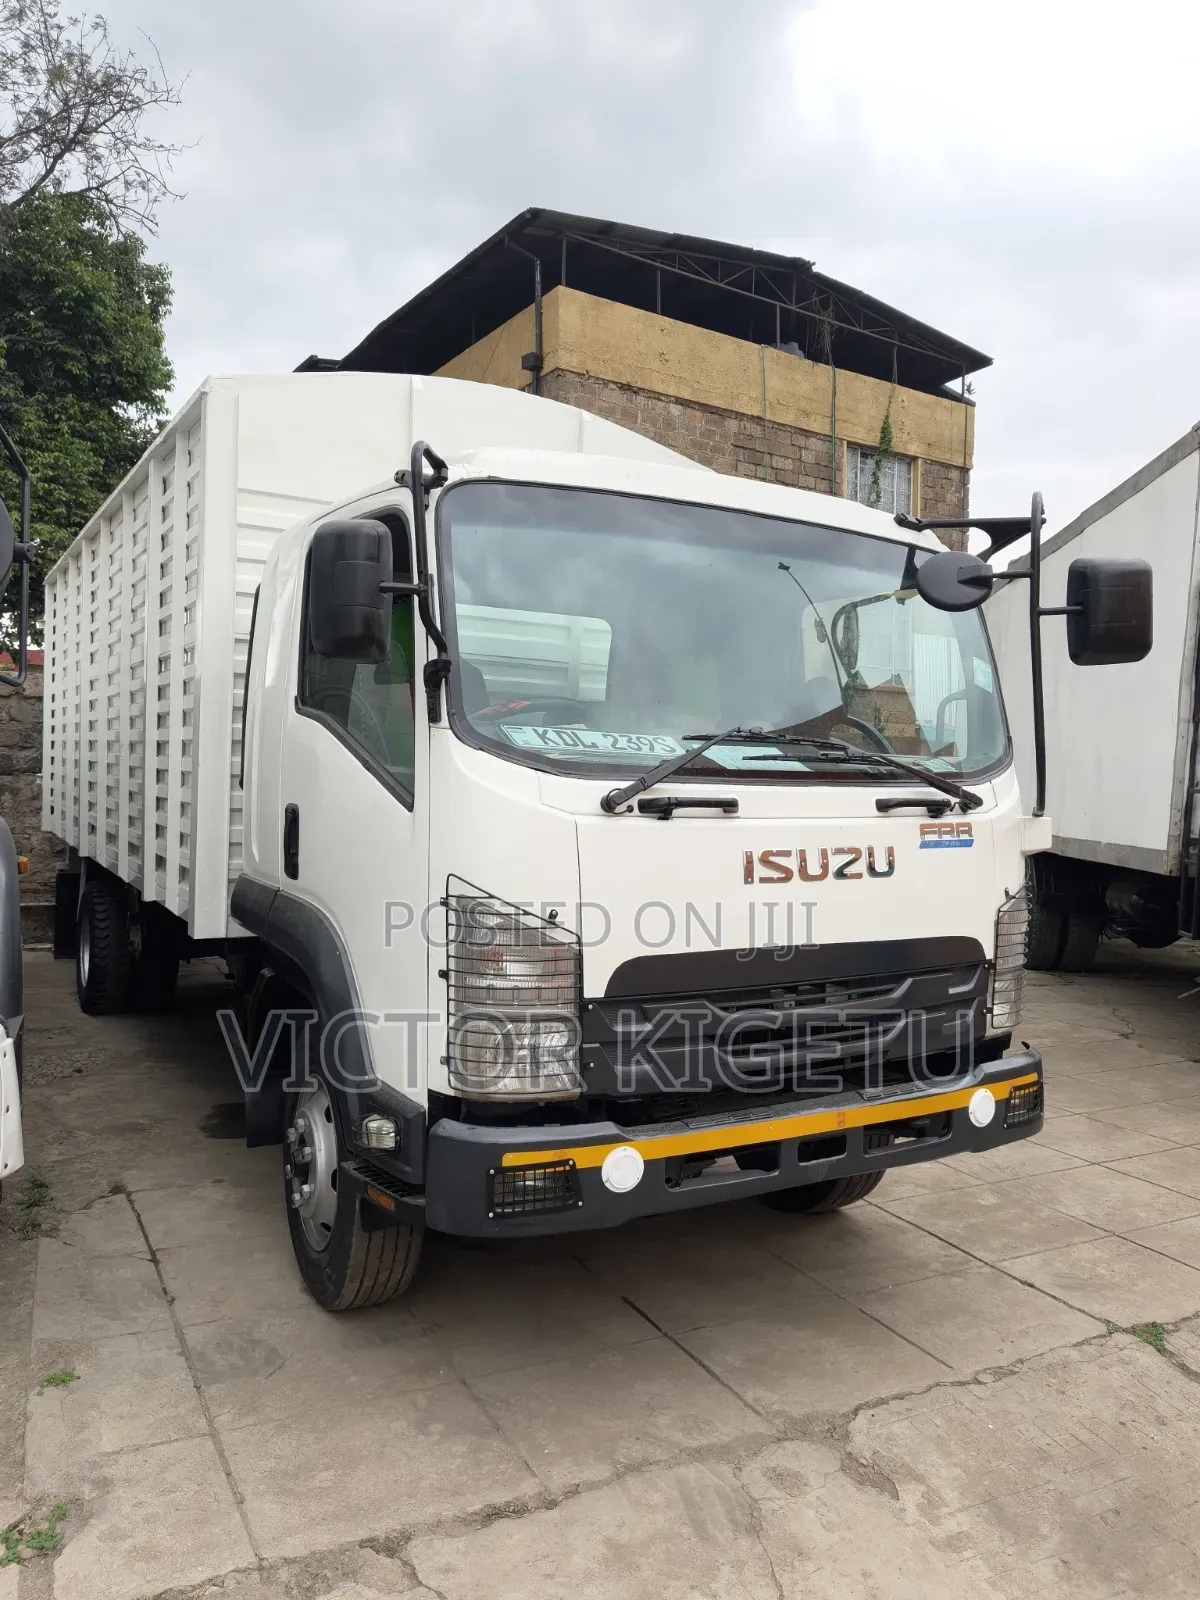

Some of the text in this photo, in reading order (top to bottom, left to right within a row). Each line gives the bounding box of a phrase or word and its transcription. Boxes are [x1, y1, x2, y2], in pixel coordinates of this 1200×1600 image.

[531, 727, 677, 753] KDL 239S
[919, 822, 974, 840] FRR
[743, 845, 896, 885] ISUZU
